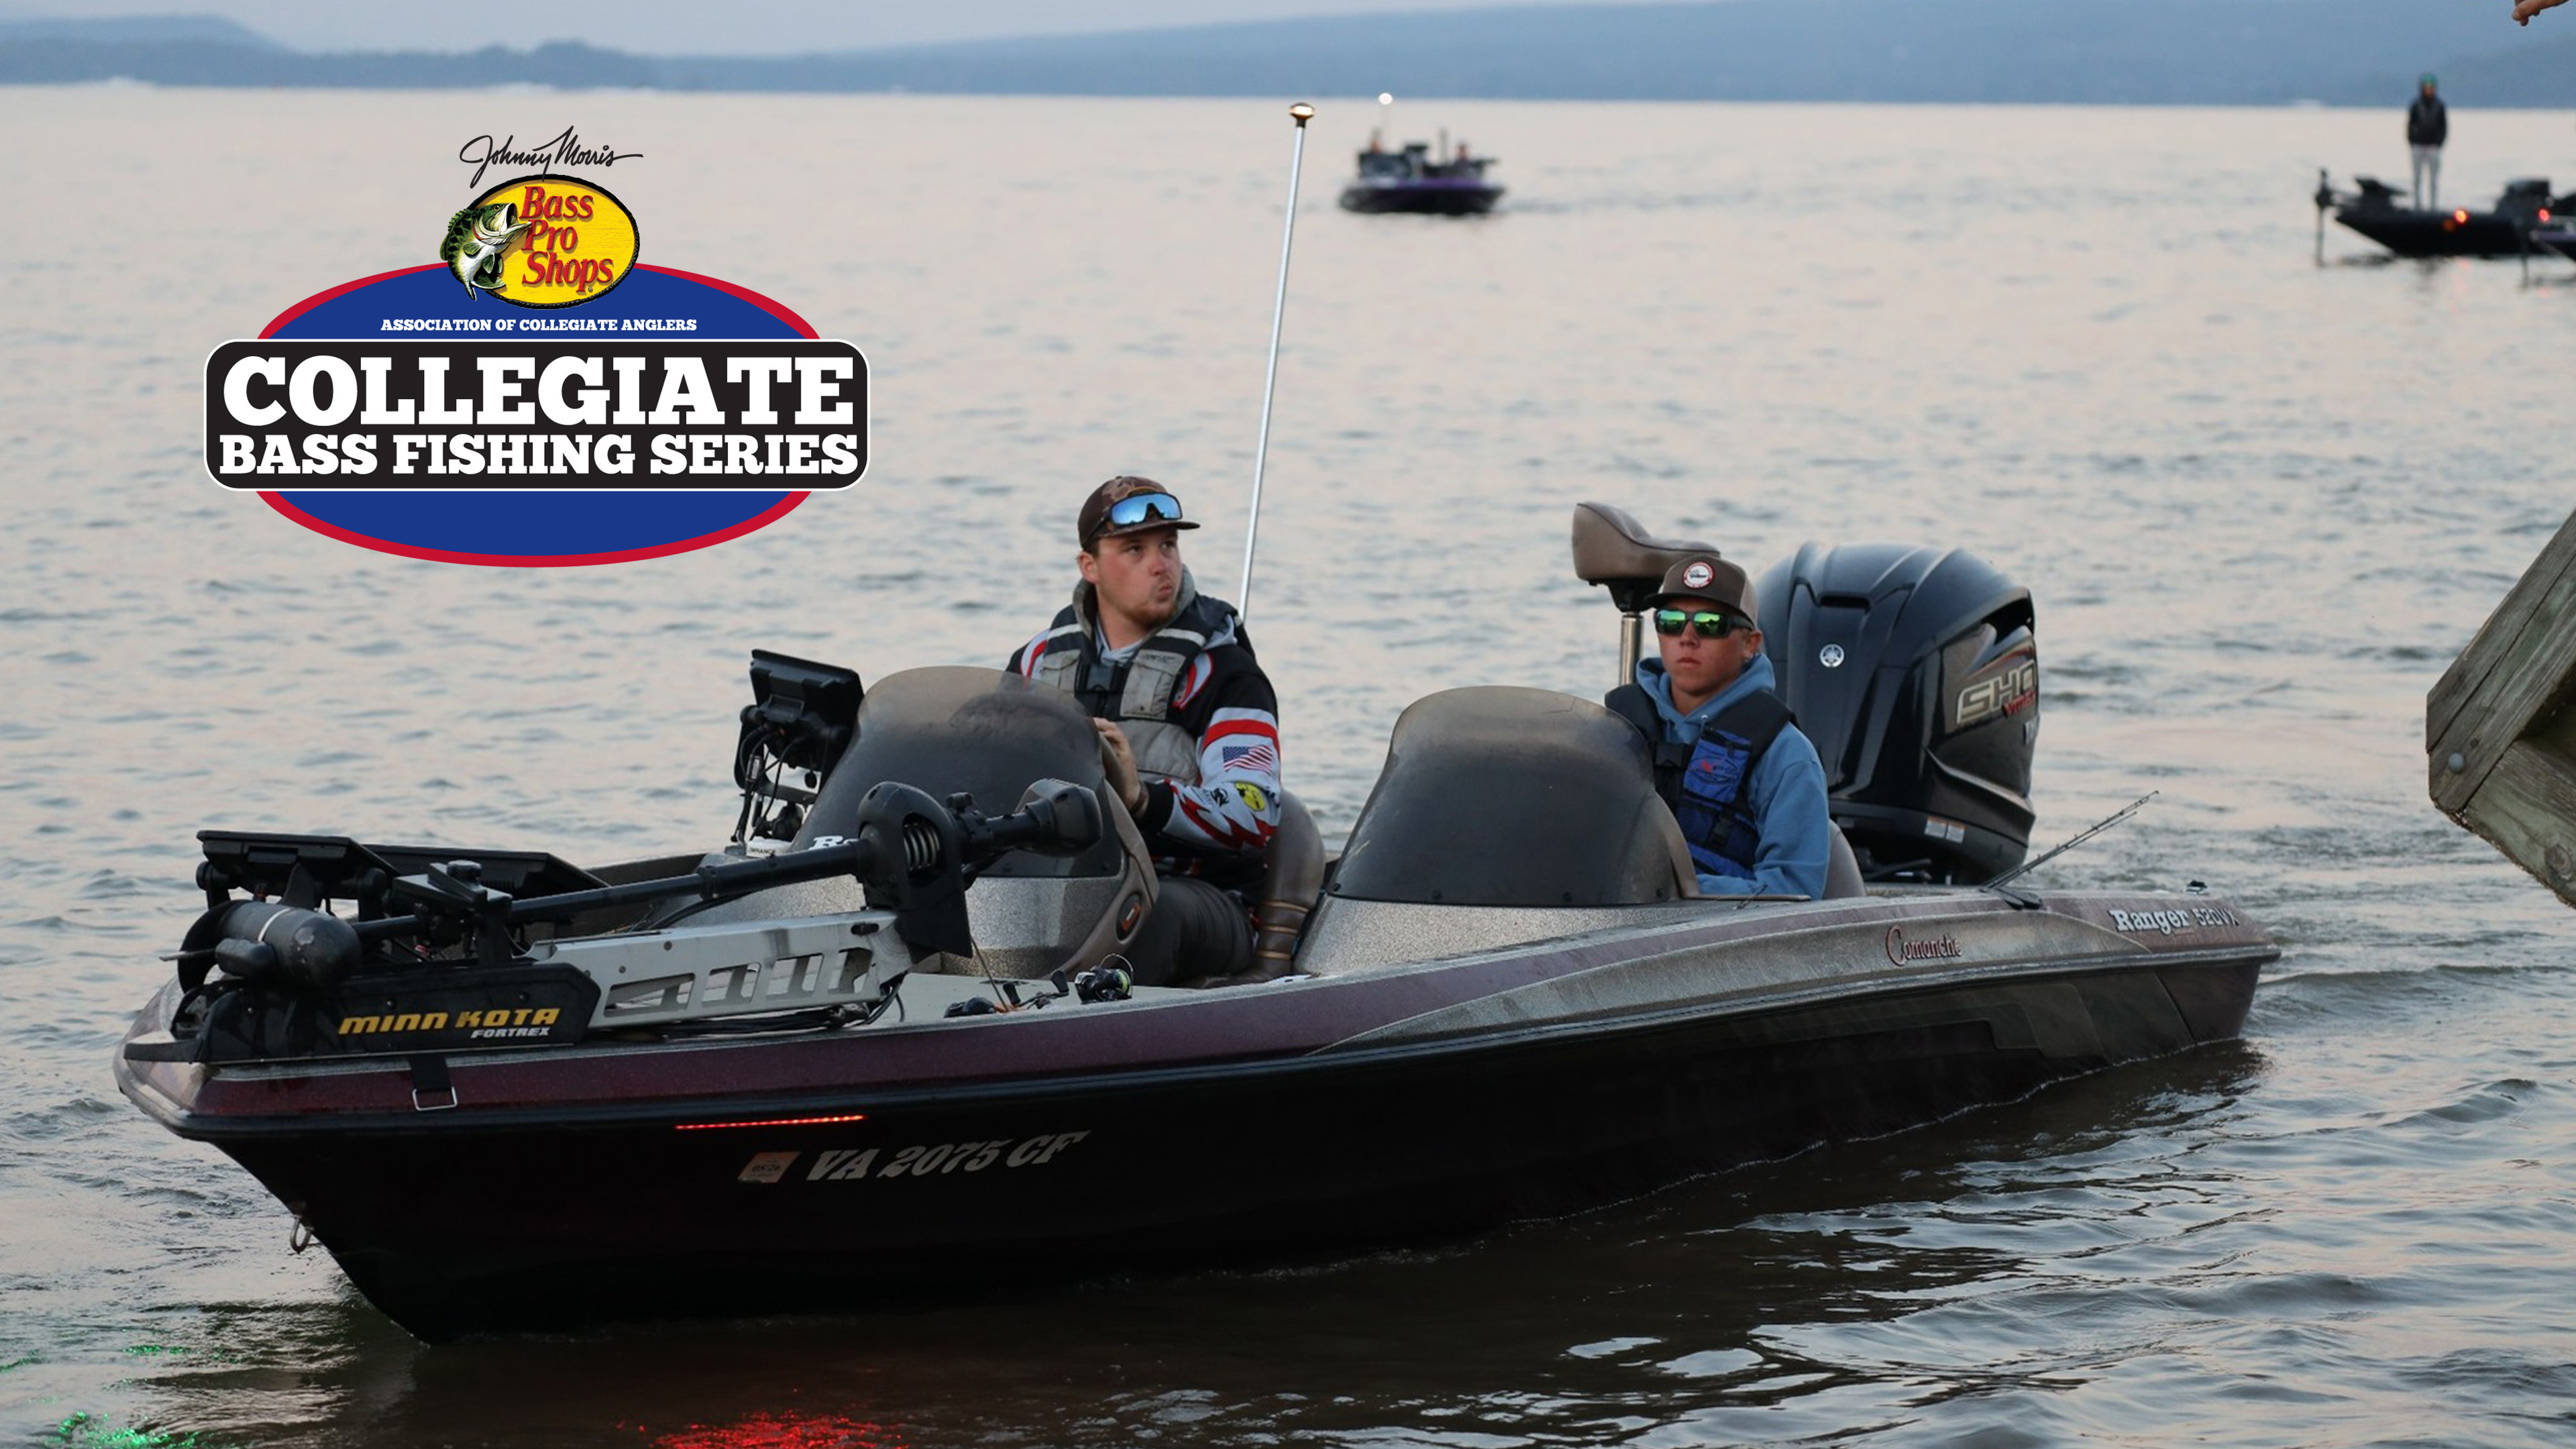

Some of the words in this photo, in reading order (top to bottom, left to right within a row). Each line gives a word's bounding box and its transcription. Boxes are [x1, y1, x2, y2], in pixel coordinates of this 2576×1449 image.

[2108, 909, 2191, 935] Ranger
[1886, 925, 1962, 967] Comanche
[454, 1008, 561, 1028] KOTA
[470, 1027, 550, 1038] FORTREX
[806, 1148, 881, 1181] VA
[876, 1139, 1013, 1178] 2075
[1006, 1130, 1092, 1167] CF
